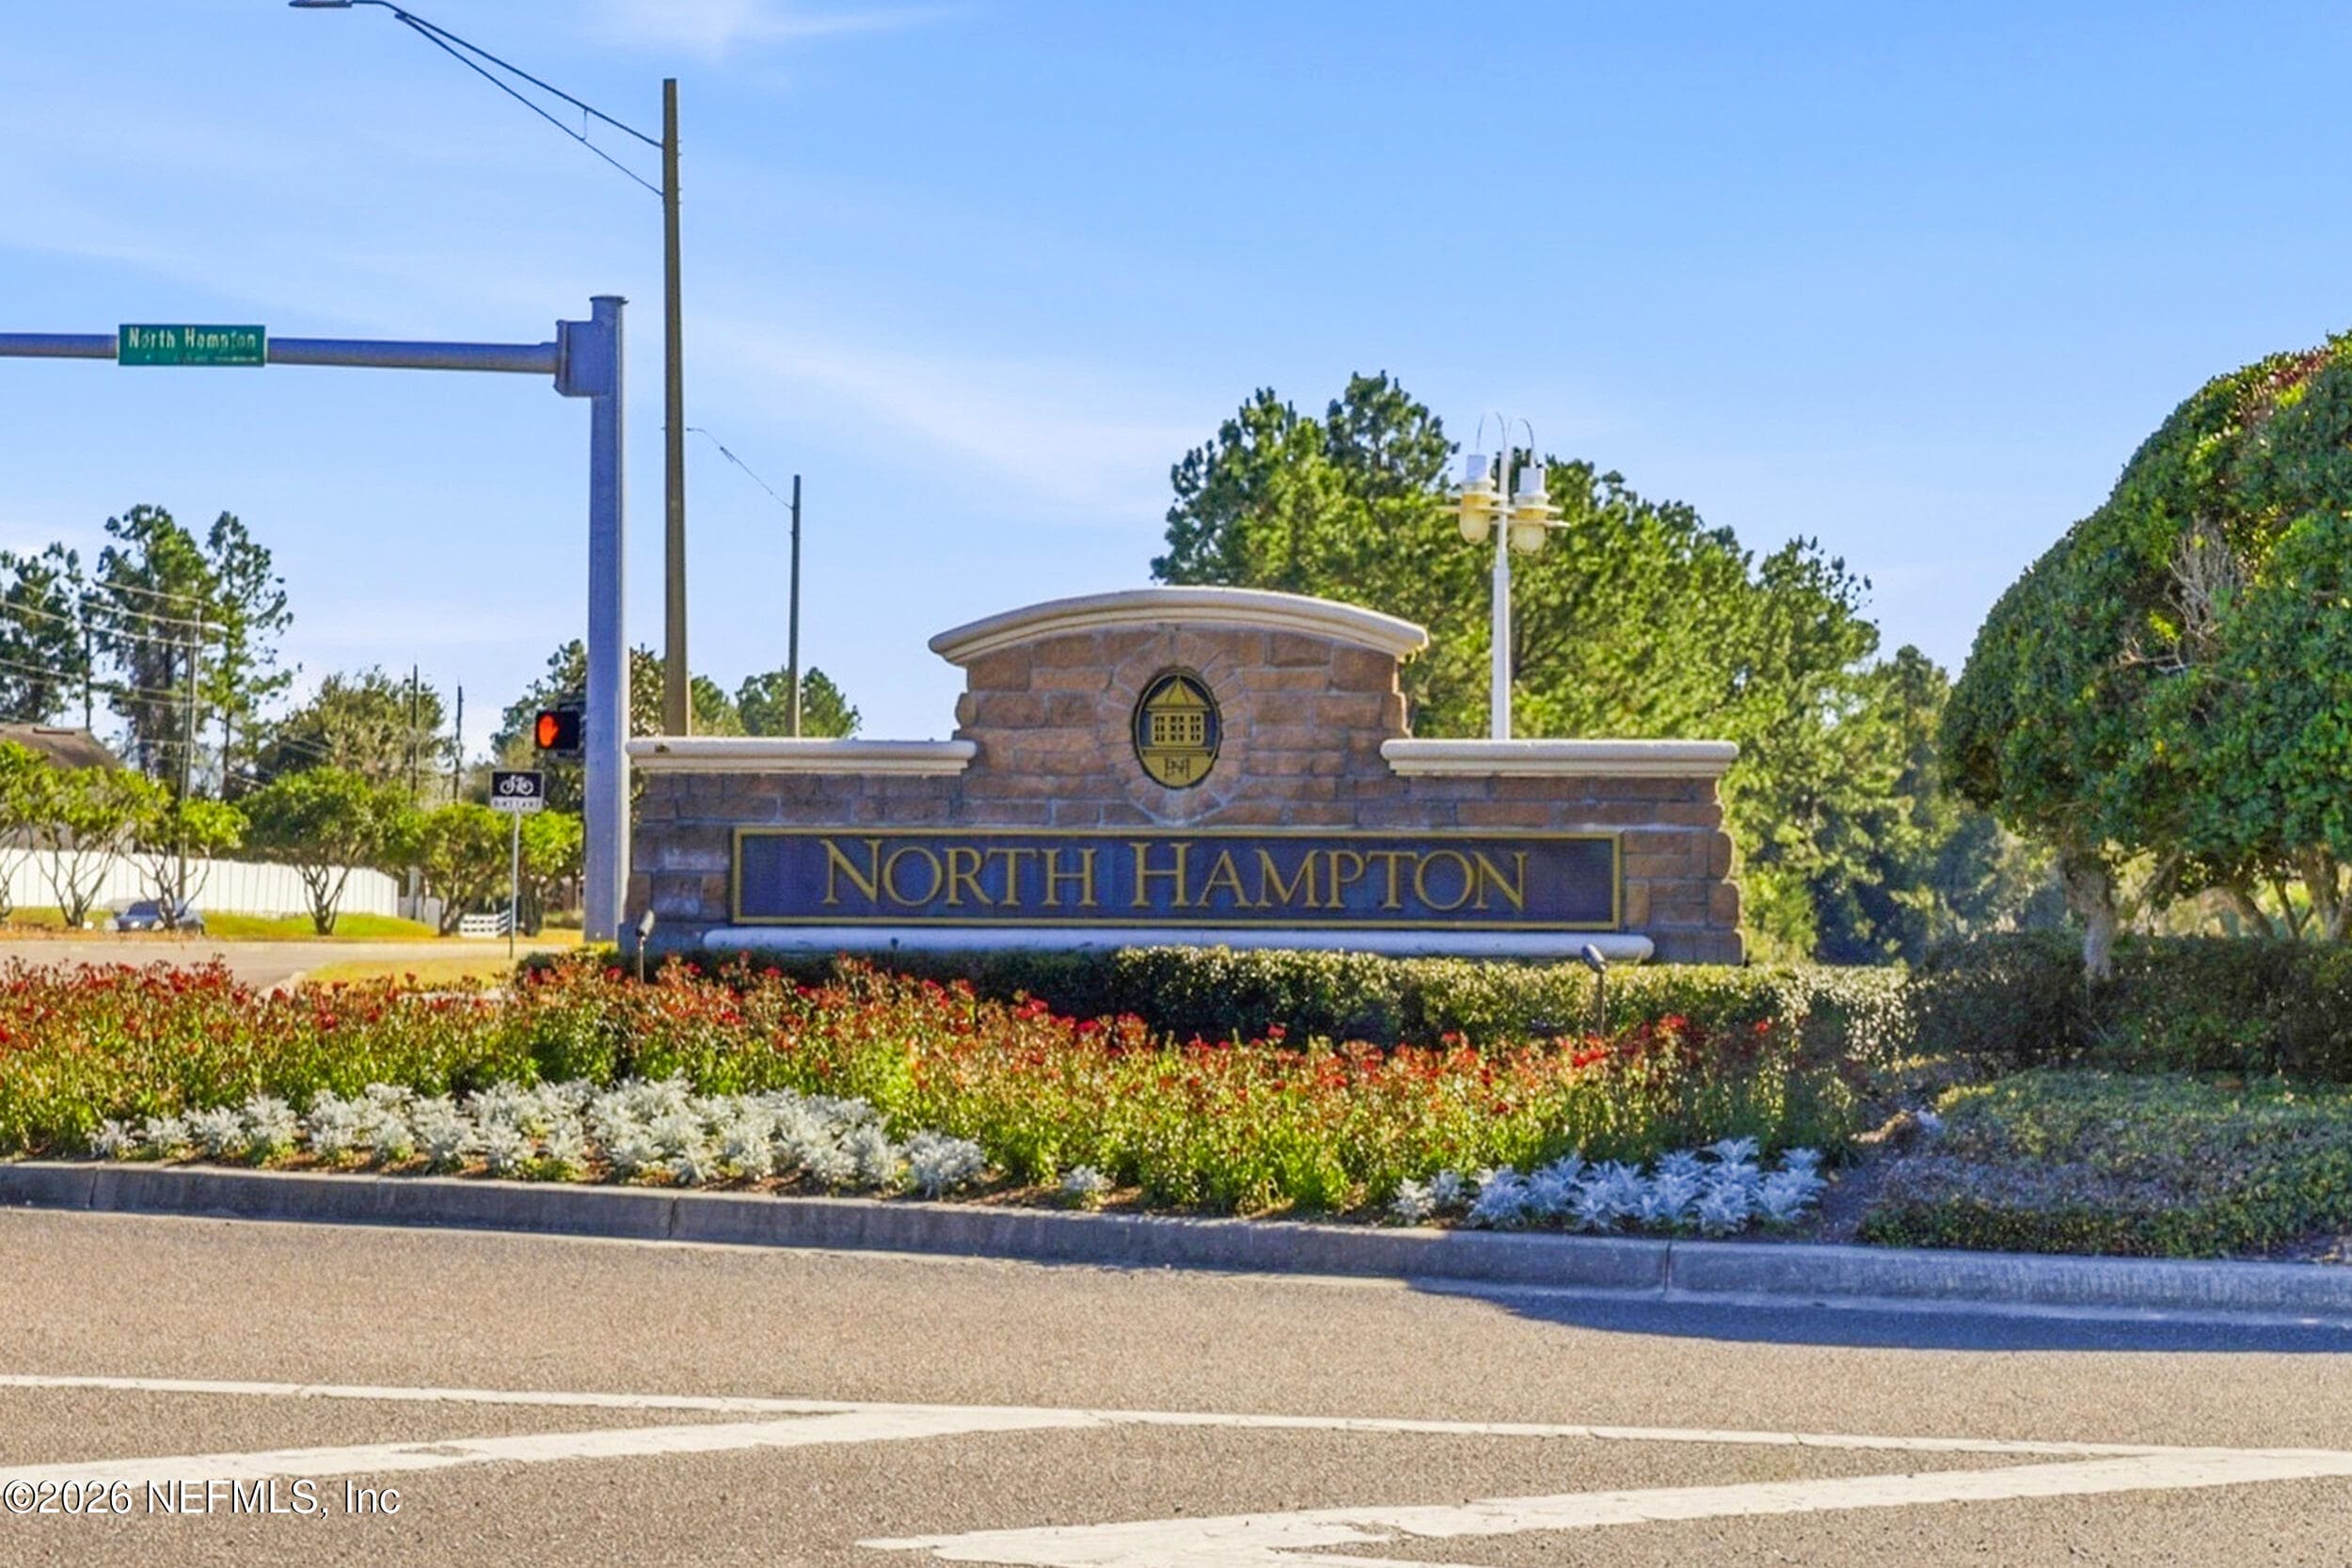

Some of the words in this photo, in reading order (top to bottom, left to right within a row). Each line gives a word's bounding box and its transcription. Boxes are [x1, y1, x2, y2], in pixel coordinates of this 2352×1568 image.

[129, 326, 176, 349] North
[820, 839, 1098, 906] NORTH
[1129, 842, 1528, 911] HAMPTON
